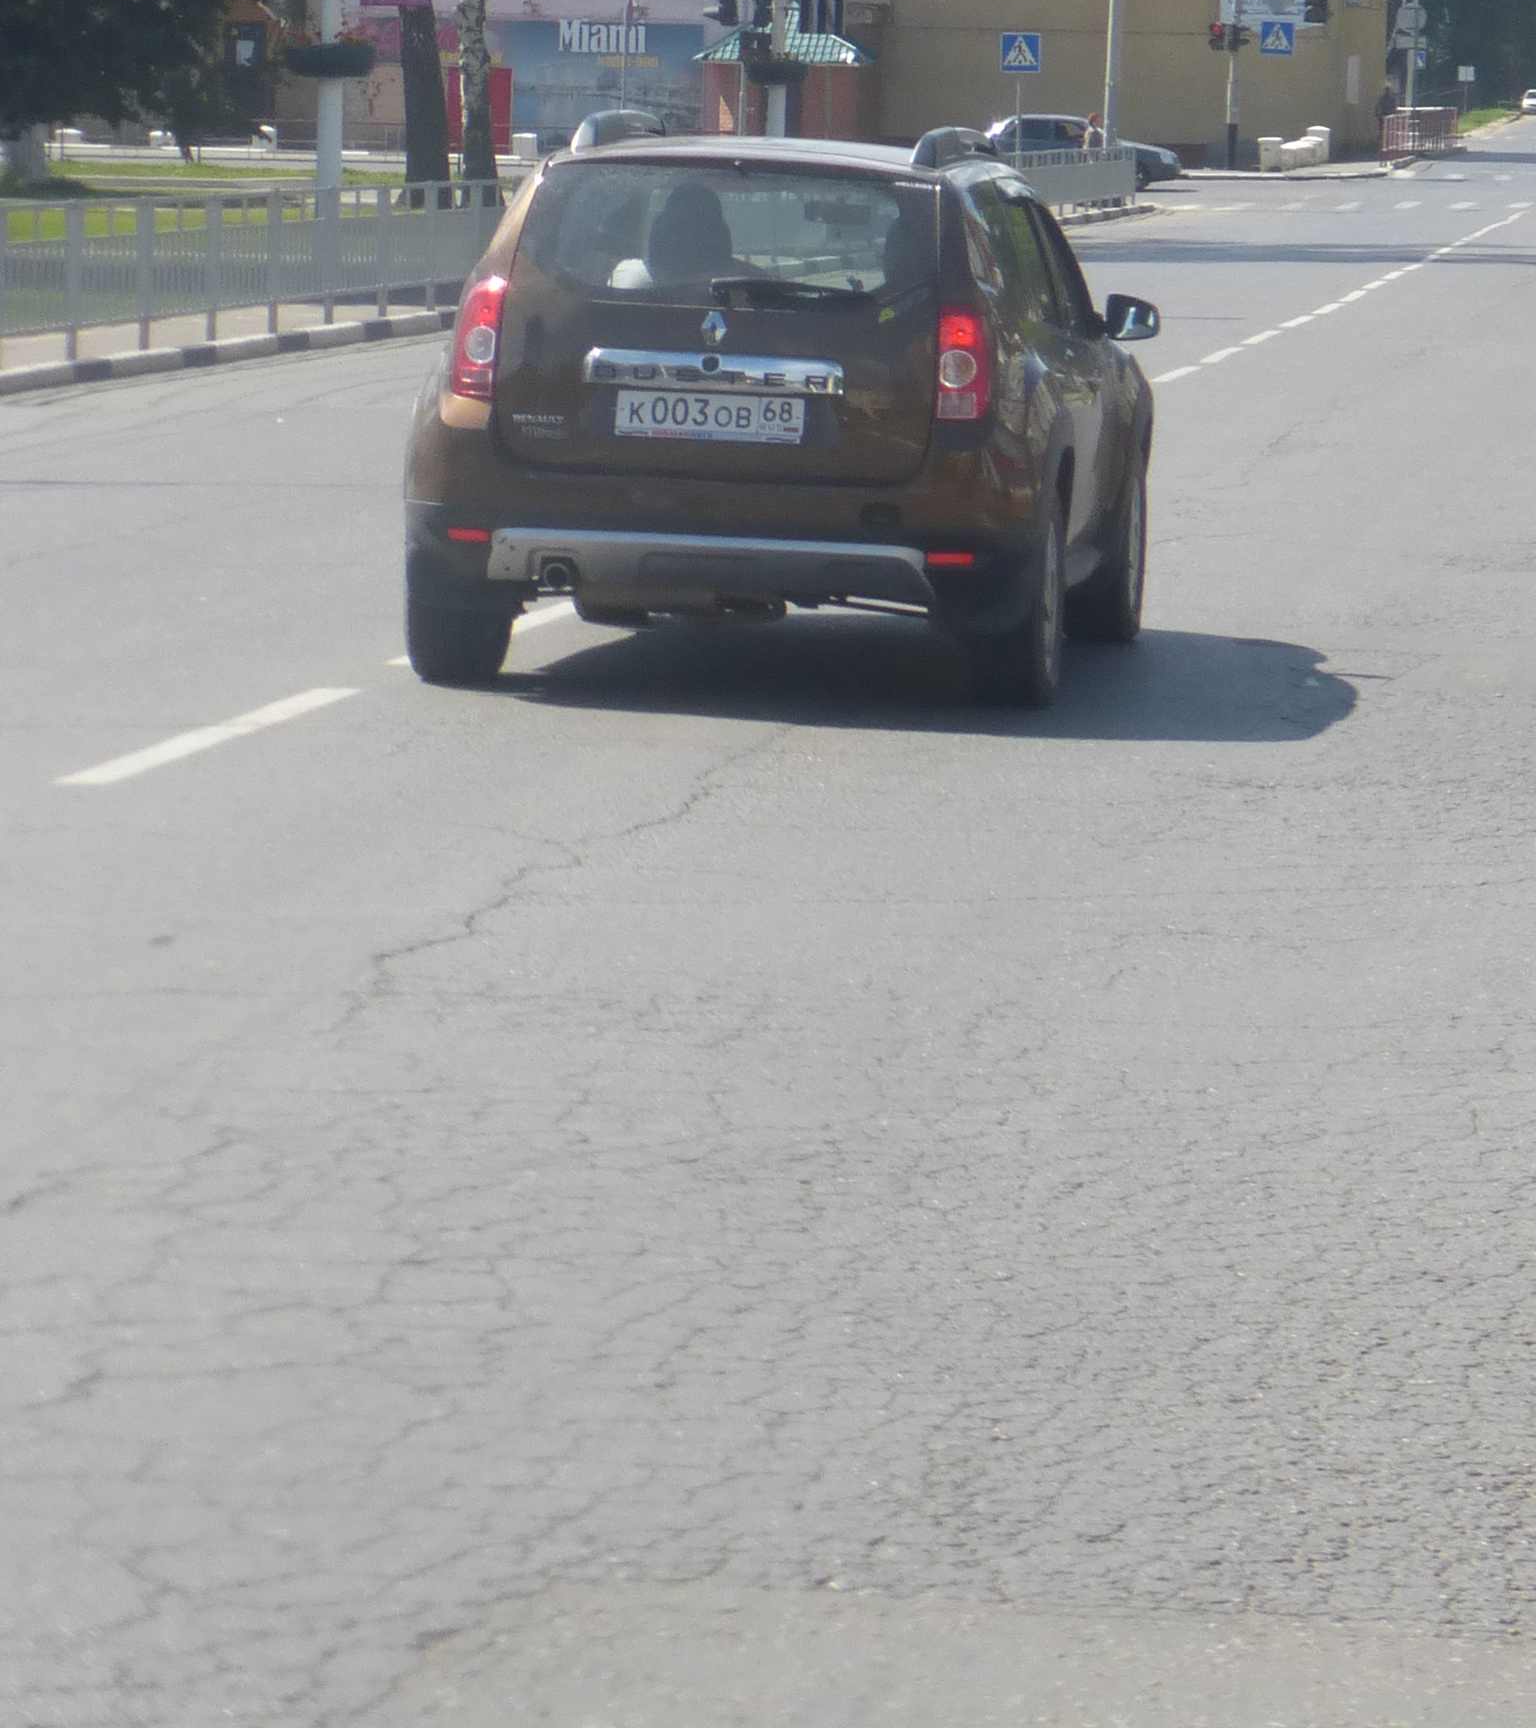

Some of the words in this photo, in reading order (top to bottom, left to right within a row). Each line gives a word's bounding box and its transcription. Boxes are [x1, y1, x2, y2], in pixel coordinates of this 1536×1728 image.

[559, 18, 646, 53] Miami
[628, 396, 750, 429] К003ОВ
[762, 401, 793, 423] 68
